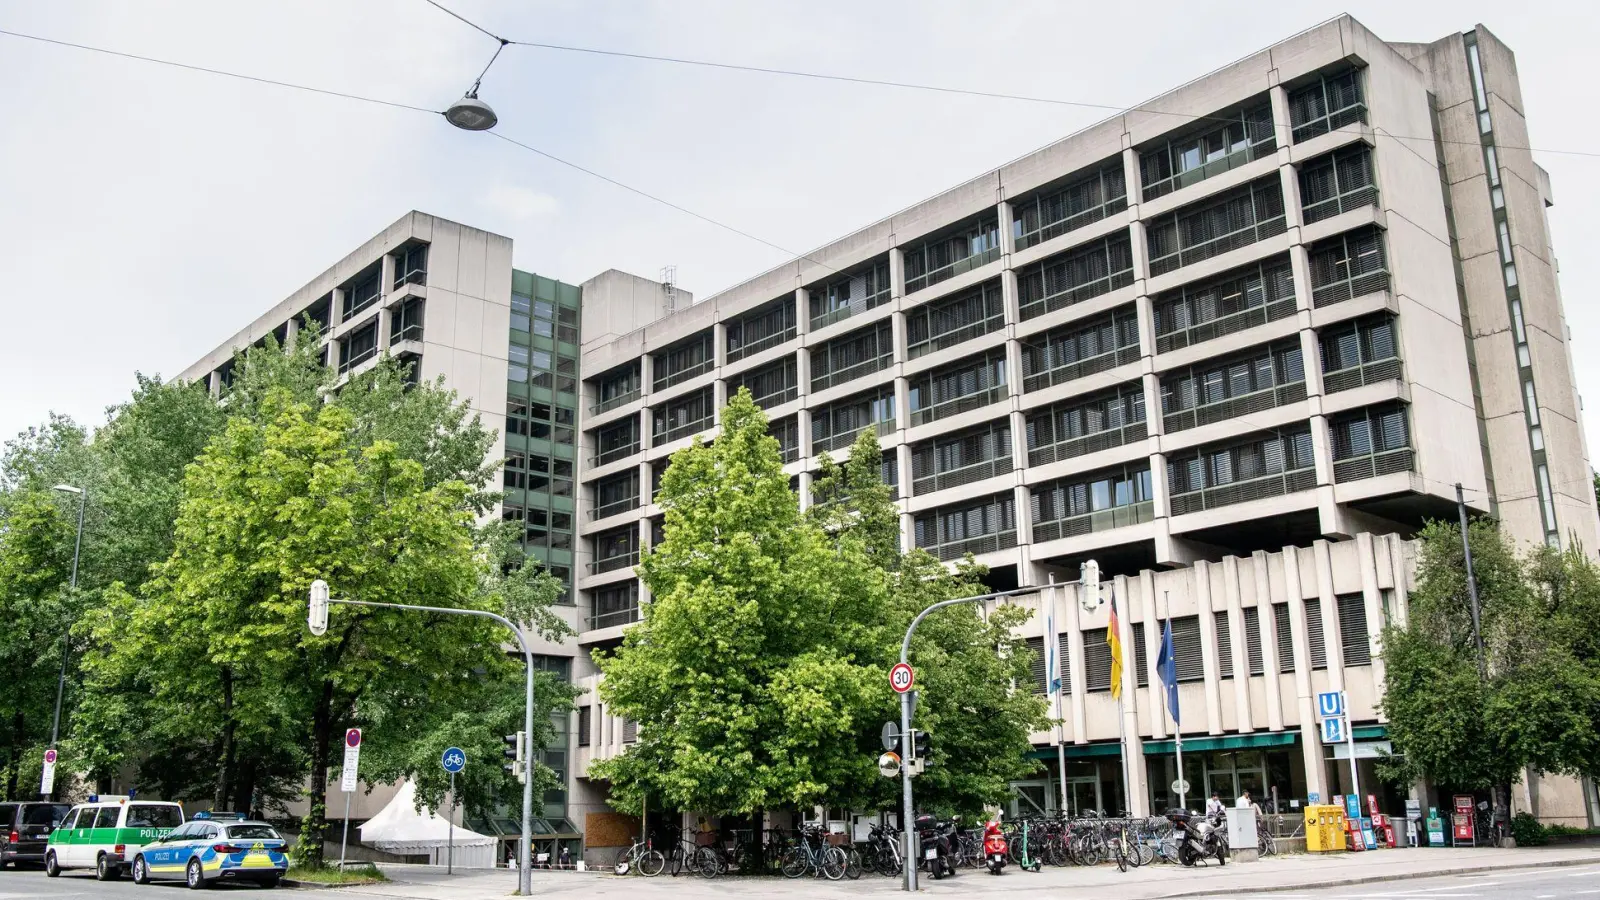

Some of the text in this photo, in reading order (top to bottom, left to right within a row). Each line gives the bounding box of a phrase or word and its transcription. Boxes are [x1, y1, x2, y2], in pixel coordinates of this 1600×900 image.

[895, 671, 909, 684] 30
[1322, 694, 1337, 713] U
[154, 852, 170, 861] POLIZEI
